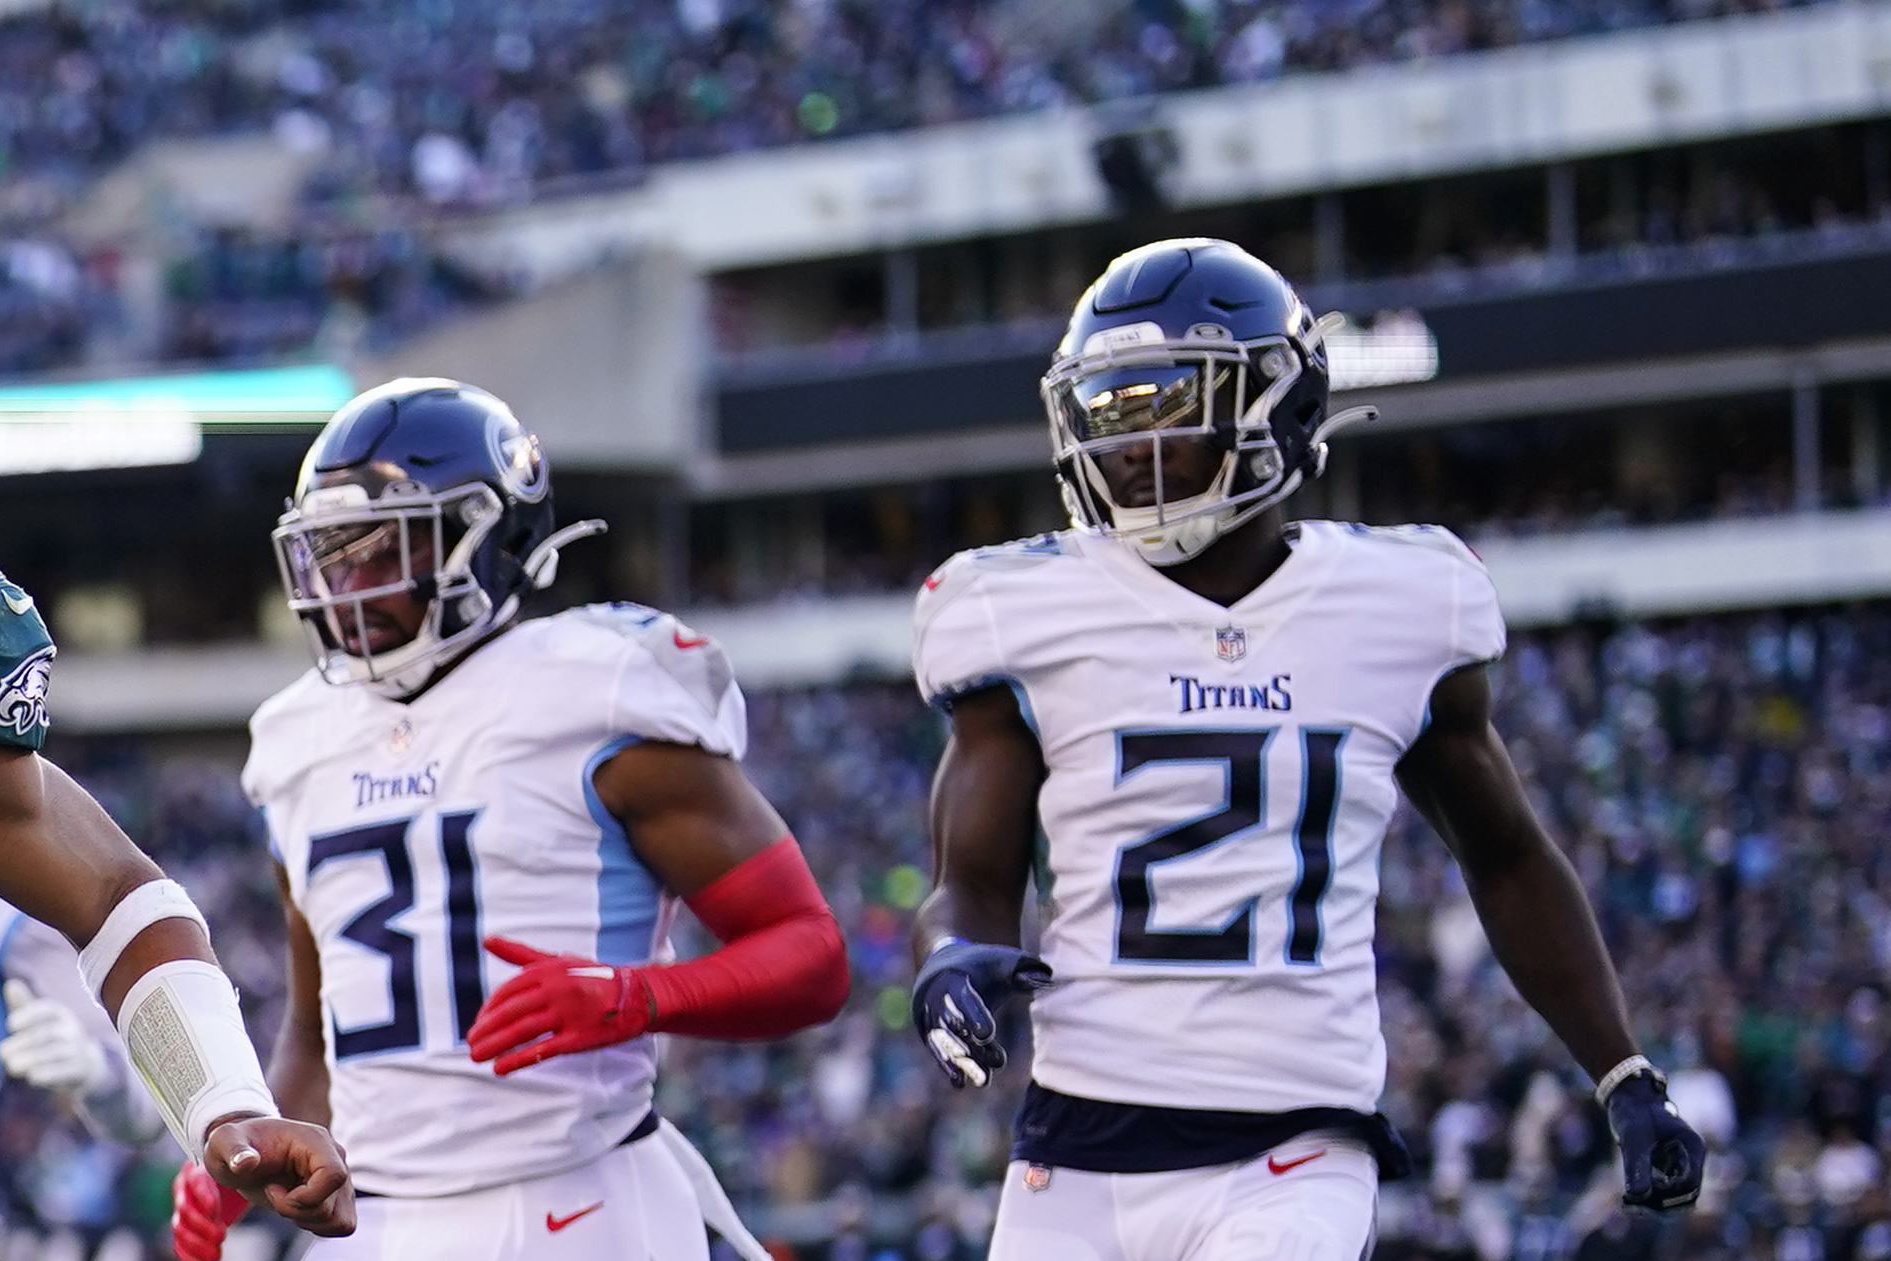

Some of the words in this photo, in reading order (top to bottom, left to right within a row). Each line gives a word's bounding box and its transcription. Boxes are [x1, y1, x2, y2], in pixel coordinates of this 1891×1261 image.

[1169, 672, 1293, 715] TITANS
[352, 759, 441, 808] TITANS
[1110, 723, 1353, 968] 21
[307, 804, 489, 1066] 31
